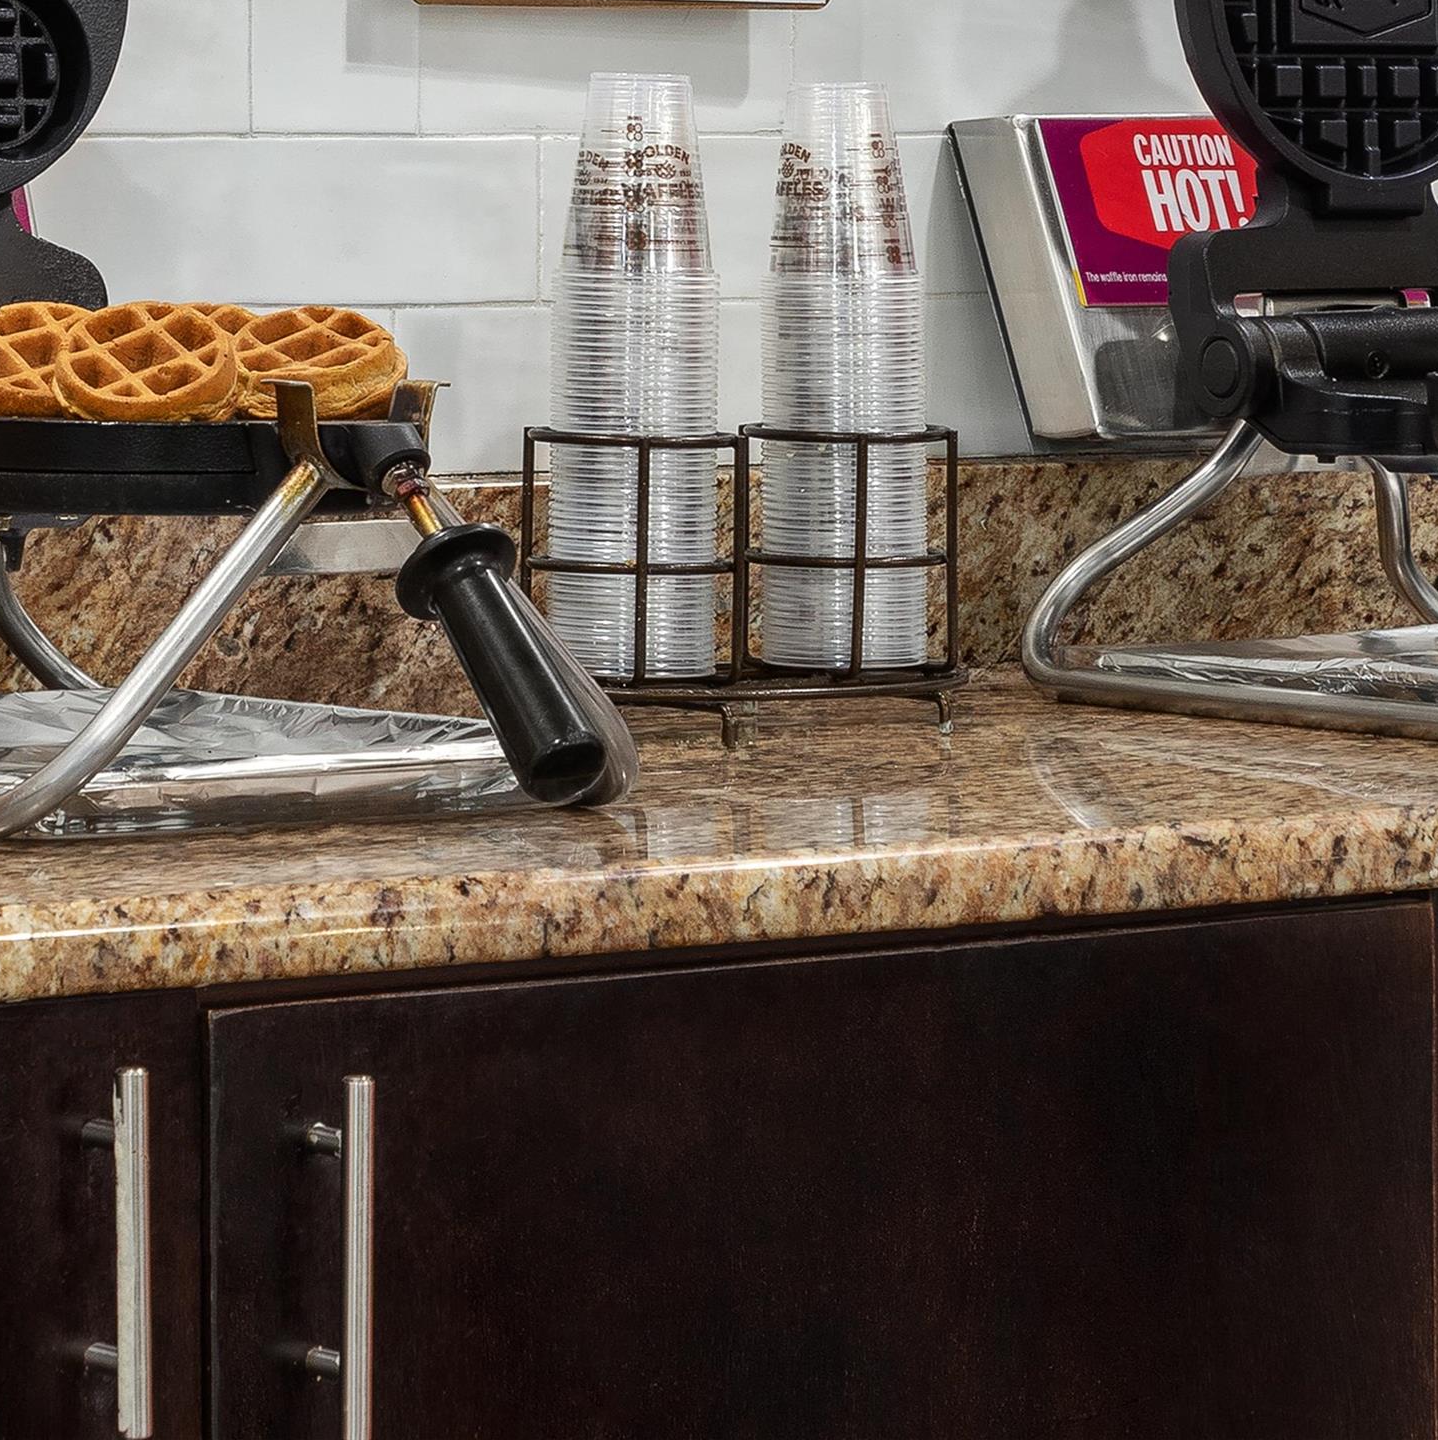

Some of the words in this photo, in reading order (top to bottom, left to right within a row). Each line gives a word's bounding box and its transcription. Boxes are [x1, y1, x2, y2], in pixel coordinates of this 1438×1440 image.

[1133, 134, 1235, 166] CAUTION
[1140, 169, 1249, 232] HOT!
[1085, 271, 1099, 282] The
[1100, 271, 1122, 282] waffle
[1122, 271, 1138, 282] iron
